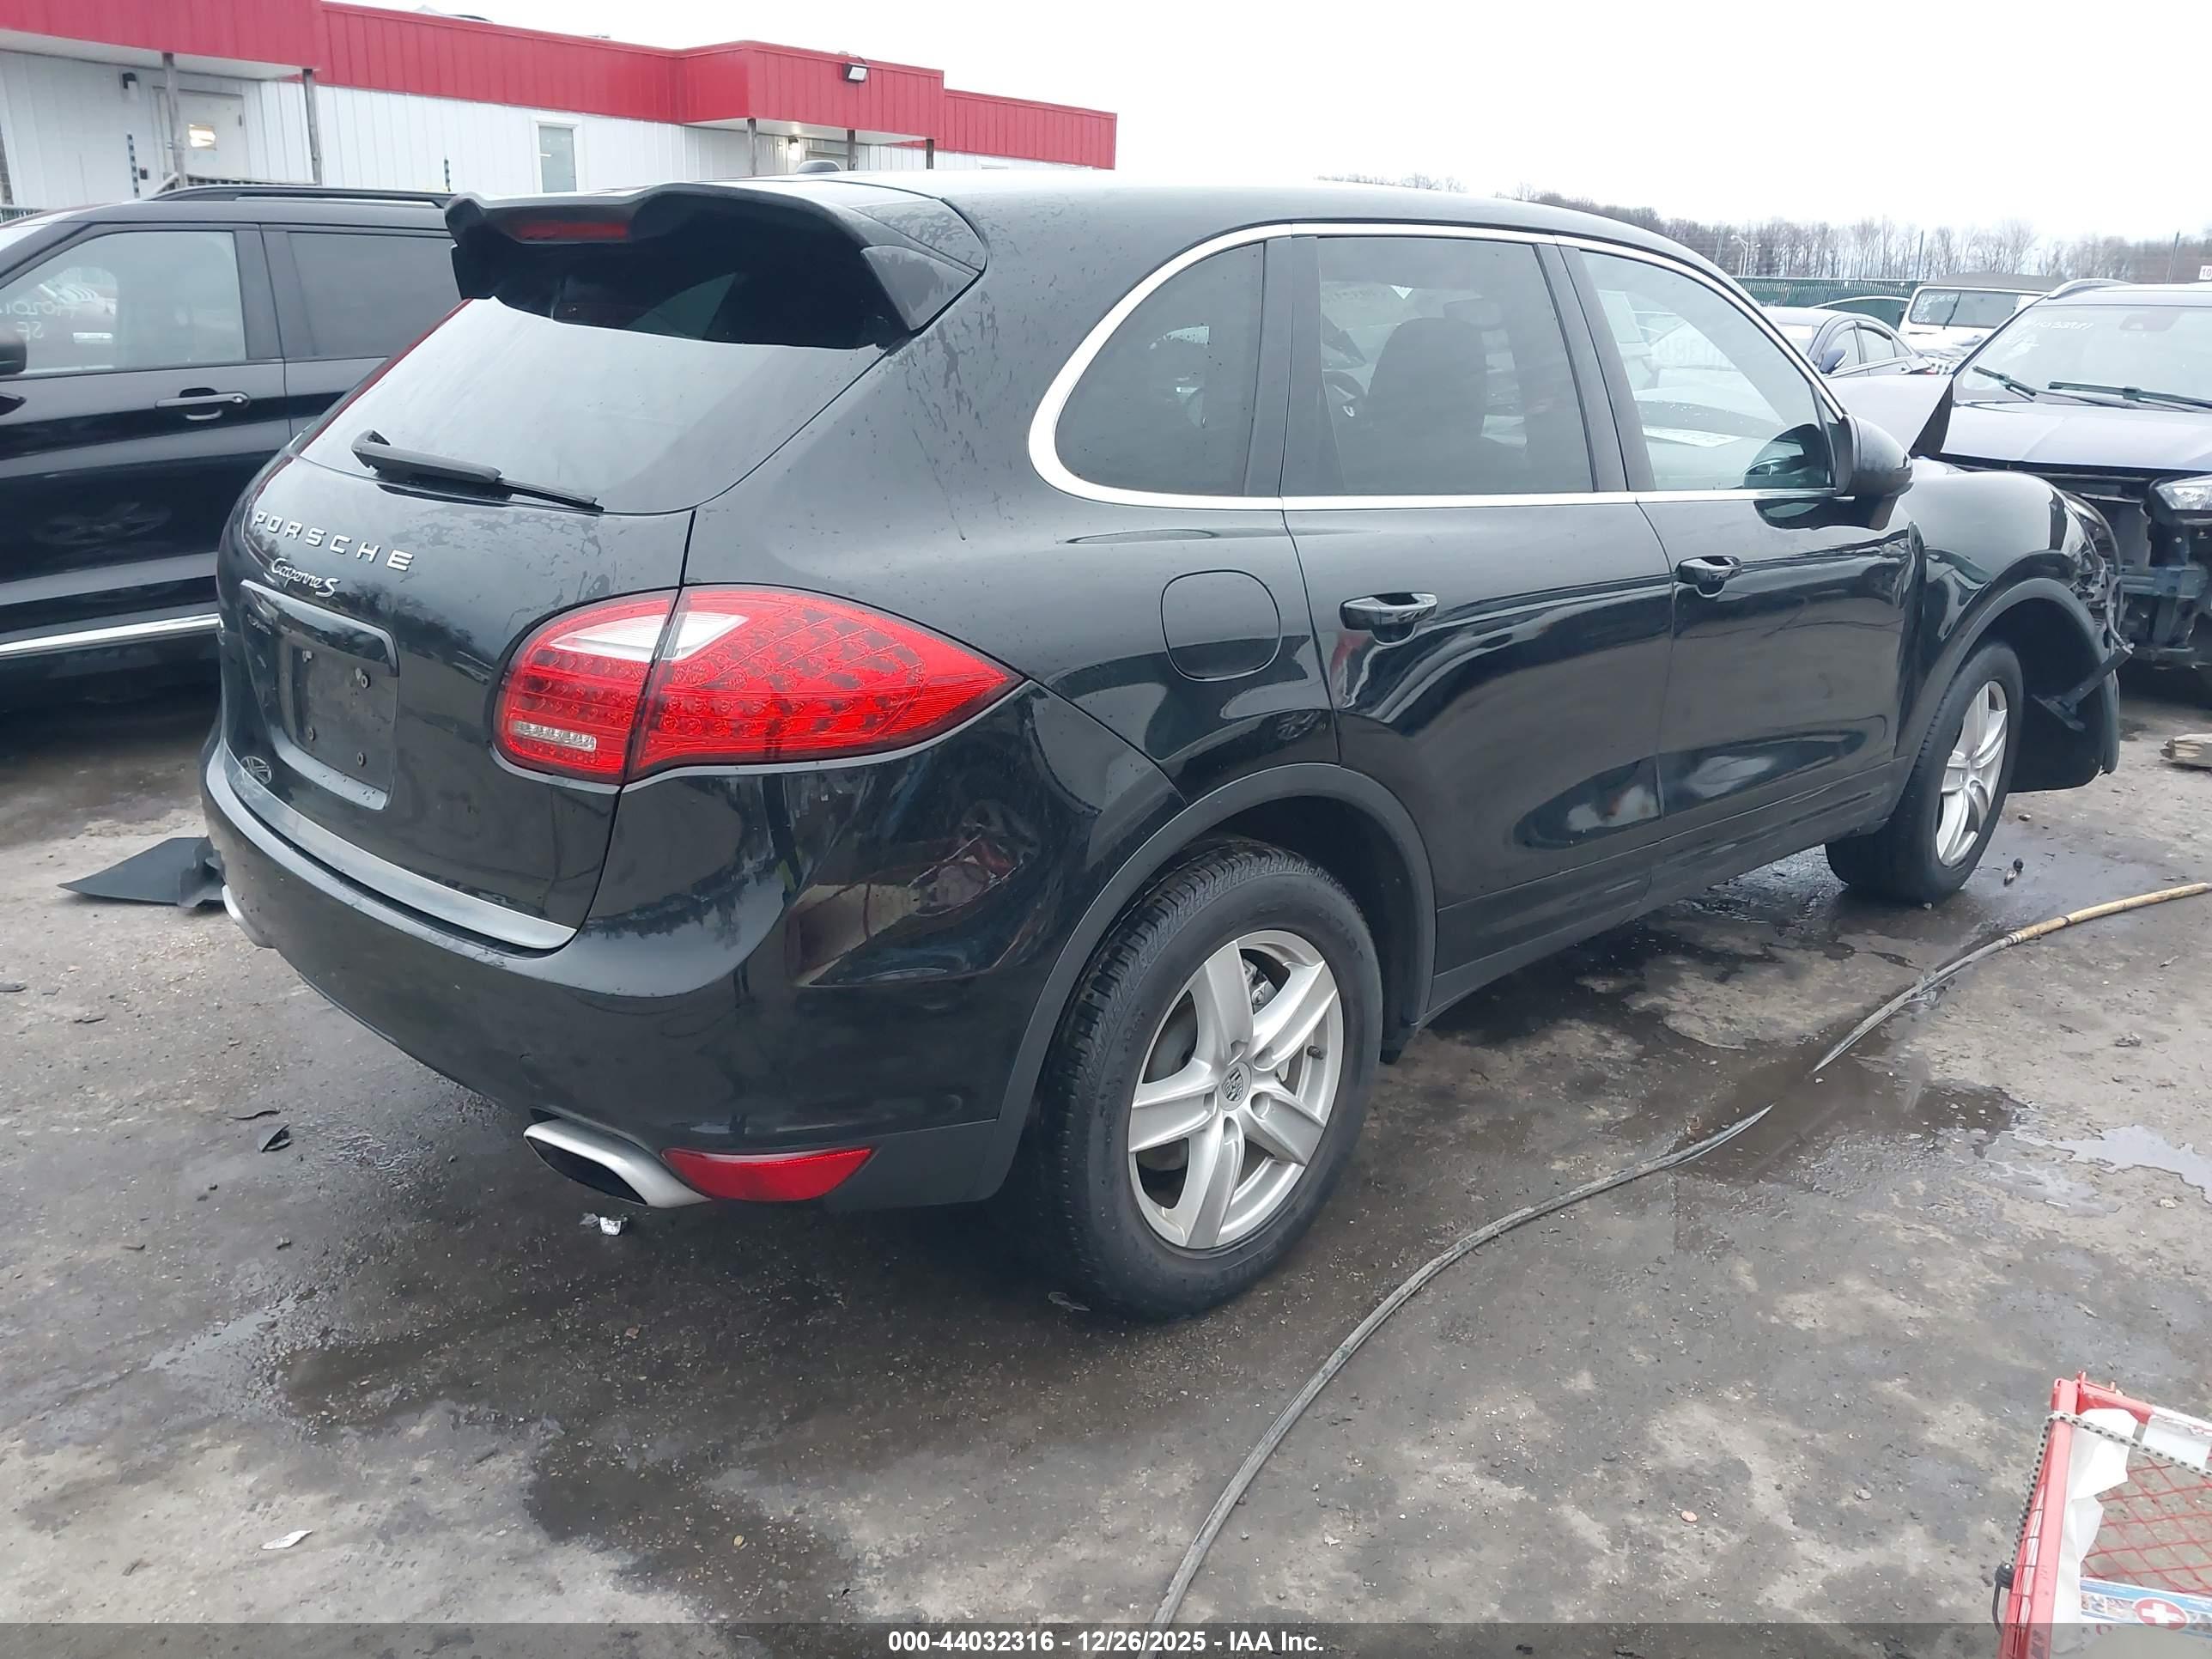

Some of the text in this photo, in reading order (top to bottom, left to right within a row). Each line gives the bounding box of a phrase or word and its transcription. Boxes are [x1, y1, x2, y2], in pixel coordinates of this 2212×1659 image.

[252, 510, 414, 571] PORSCHE
[270, 557, 340, 598] Cayenne S
